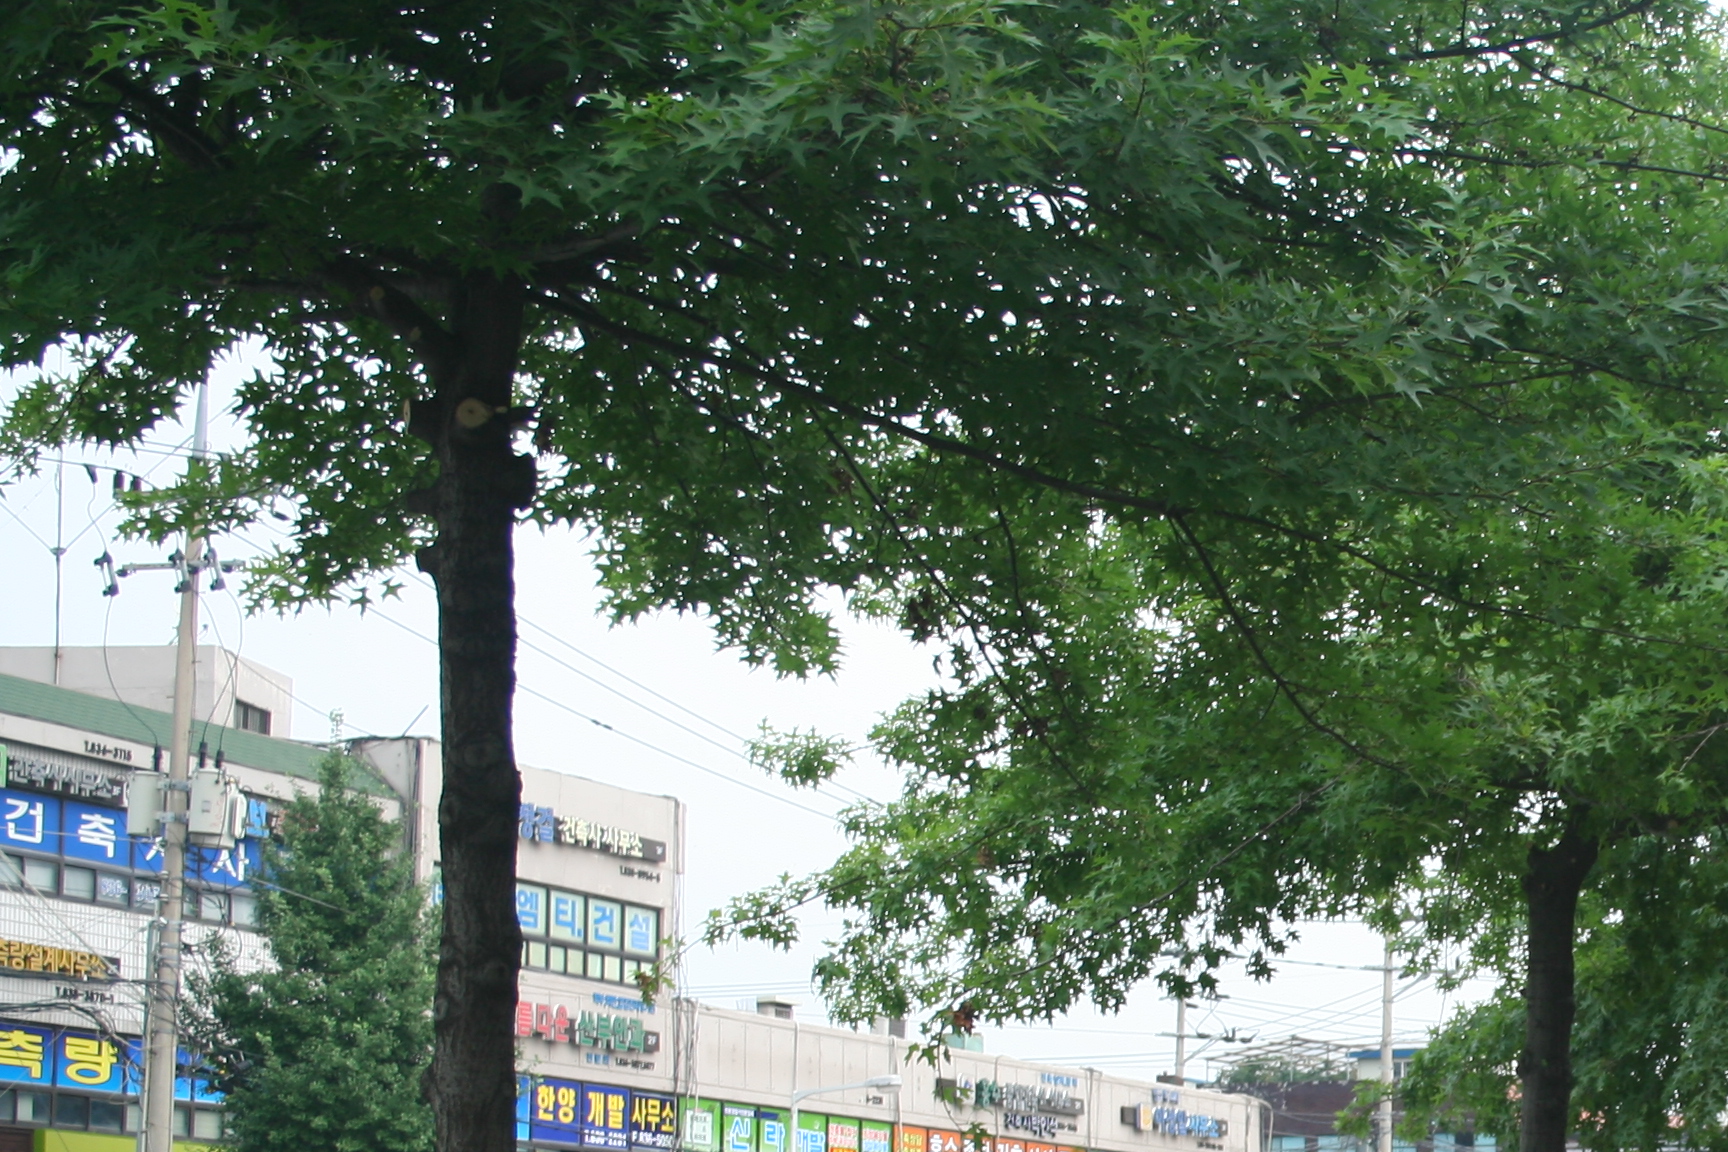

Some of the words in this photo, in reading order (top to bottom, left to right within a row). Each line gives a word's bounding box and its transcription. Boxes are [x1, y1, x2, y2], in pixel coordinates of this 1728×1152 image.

[536, 1084, 576, 1124] 한양
[587, 1091, 625, 1130] 개발
[632, 1096, 674, 1132] 사무소
